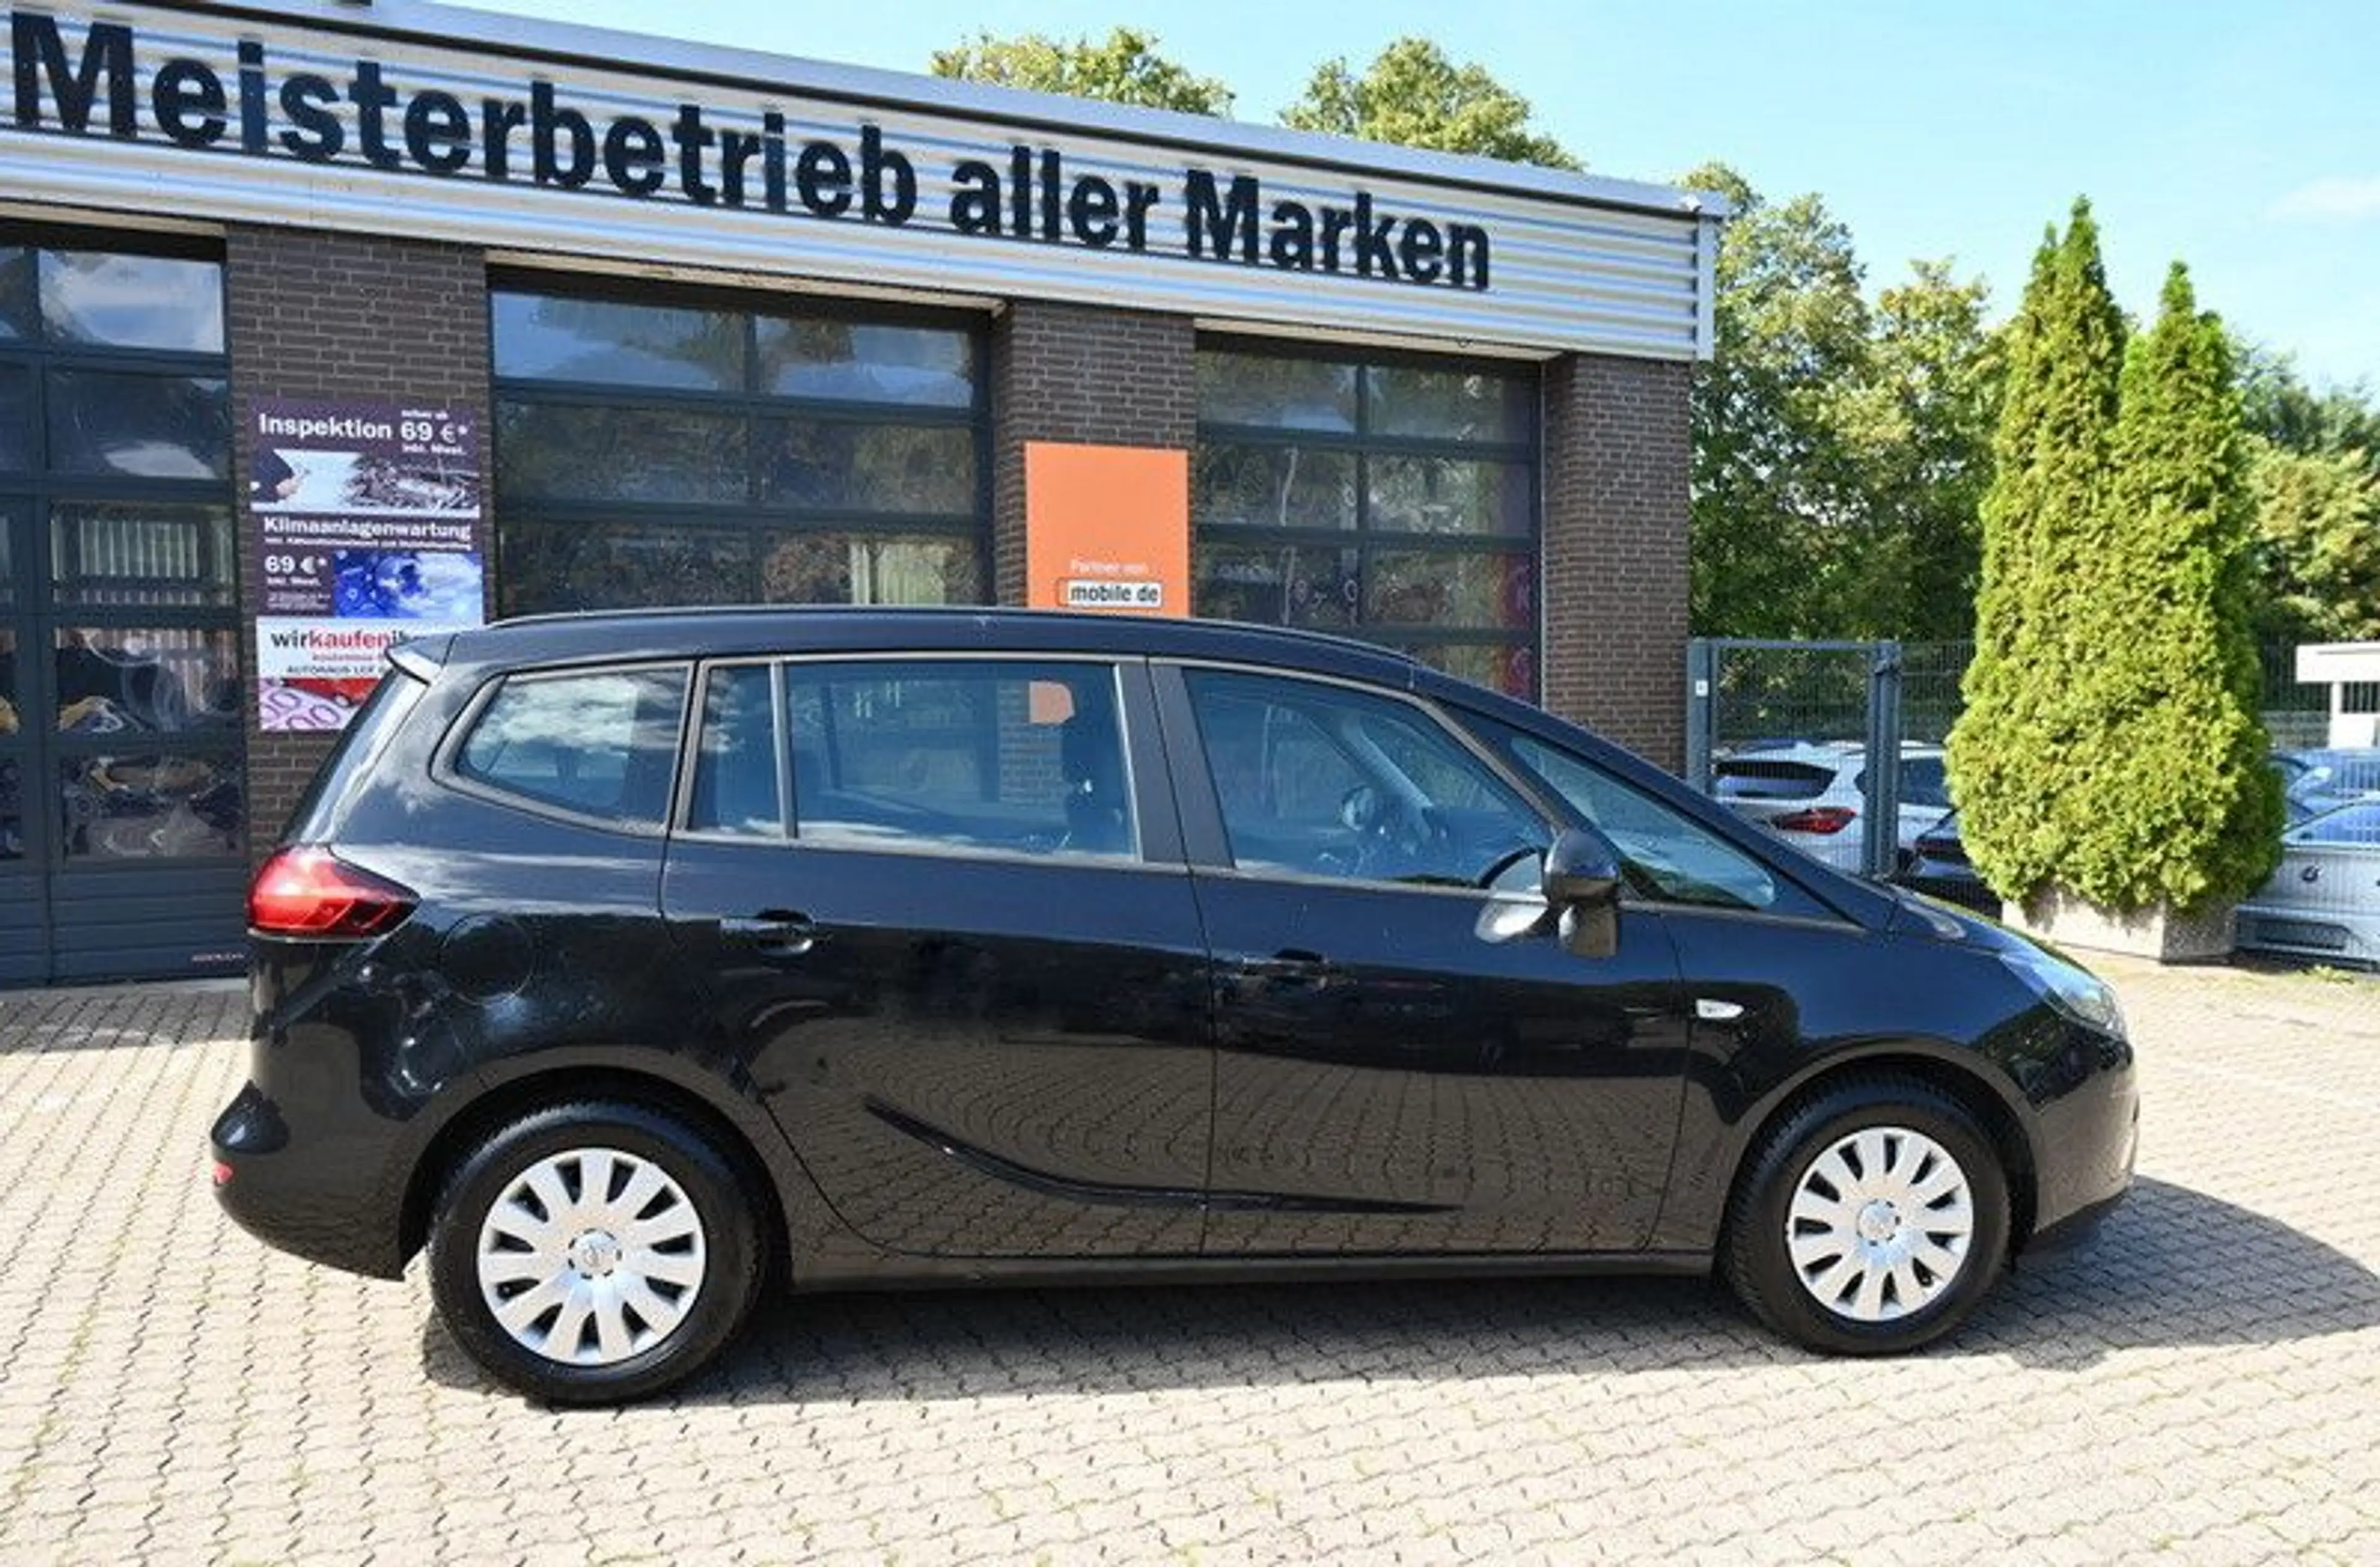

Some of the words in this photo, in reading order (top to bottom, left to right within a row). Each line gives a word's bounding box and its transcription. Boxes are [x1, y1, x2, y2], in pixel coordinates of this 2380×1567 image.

[11, 11, 917, 226] Meisterbetrieb
[948, 144, 1159, 249] aller
[1184, 167, 1490, 291] Marken
[258, 413, 392, 439] Inspektion
[401, 421, 433, 441] 69
[264, 517, 471, 540] Klimaanlagenwartung
[265, 555, 295, 574] 69
